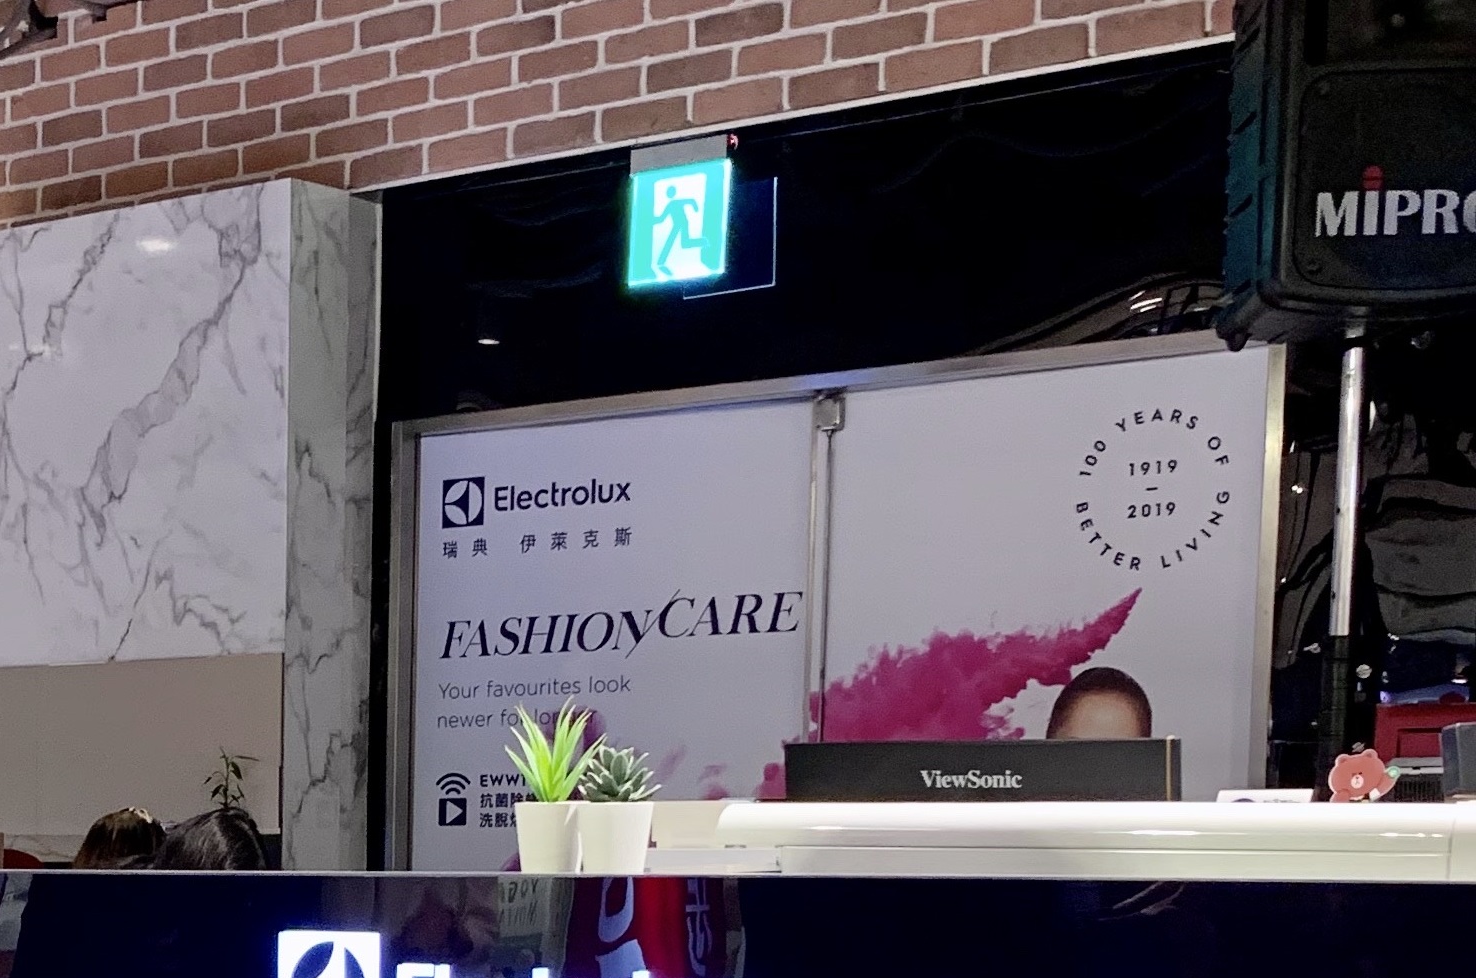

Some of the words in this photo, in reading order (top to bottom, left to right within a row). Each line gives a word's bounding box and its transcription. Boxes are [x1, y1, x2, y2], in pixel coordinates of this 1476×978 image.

[1079, 440, 1107, 476] 100
[1115, 408, 1199, 432] YEARS
[1207, 436, 1230, 466] OF
[1128, 459, 1178, 477] 1919
[494, 478, 632, 512] Electrolux
[1126, 501, 1176, 519] 2019
[1076, 501, 1141, 571] BETTER
[1160, 490, 1230, 569] LIVING
[442, 537, 488, 560] 瑞典
[438, 682, 479, 700] Your
[486, 679, 582, 698] favourites
[588, 675, 632, 693] look
[436, 713, 493, 729] newer
[920, 768, 1023, 789] ViewSonic
